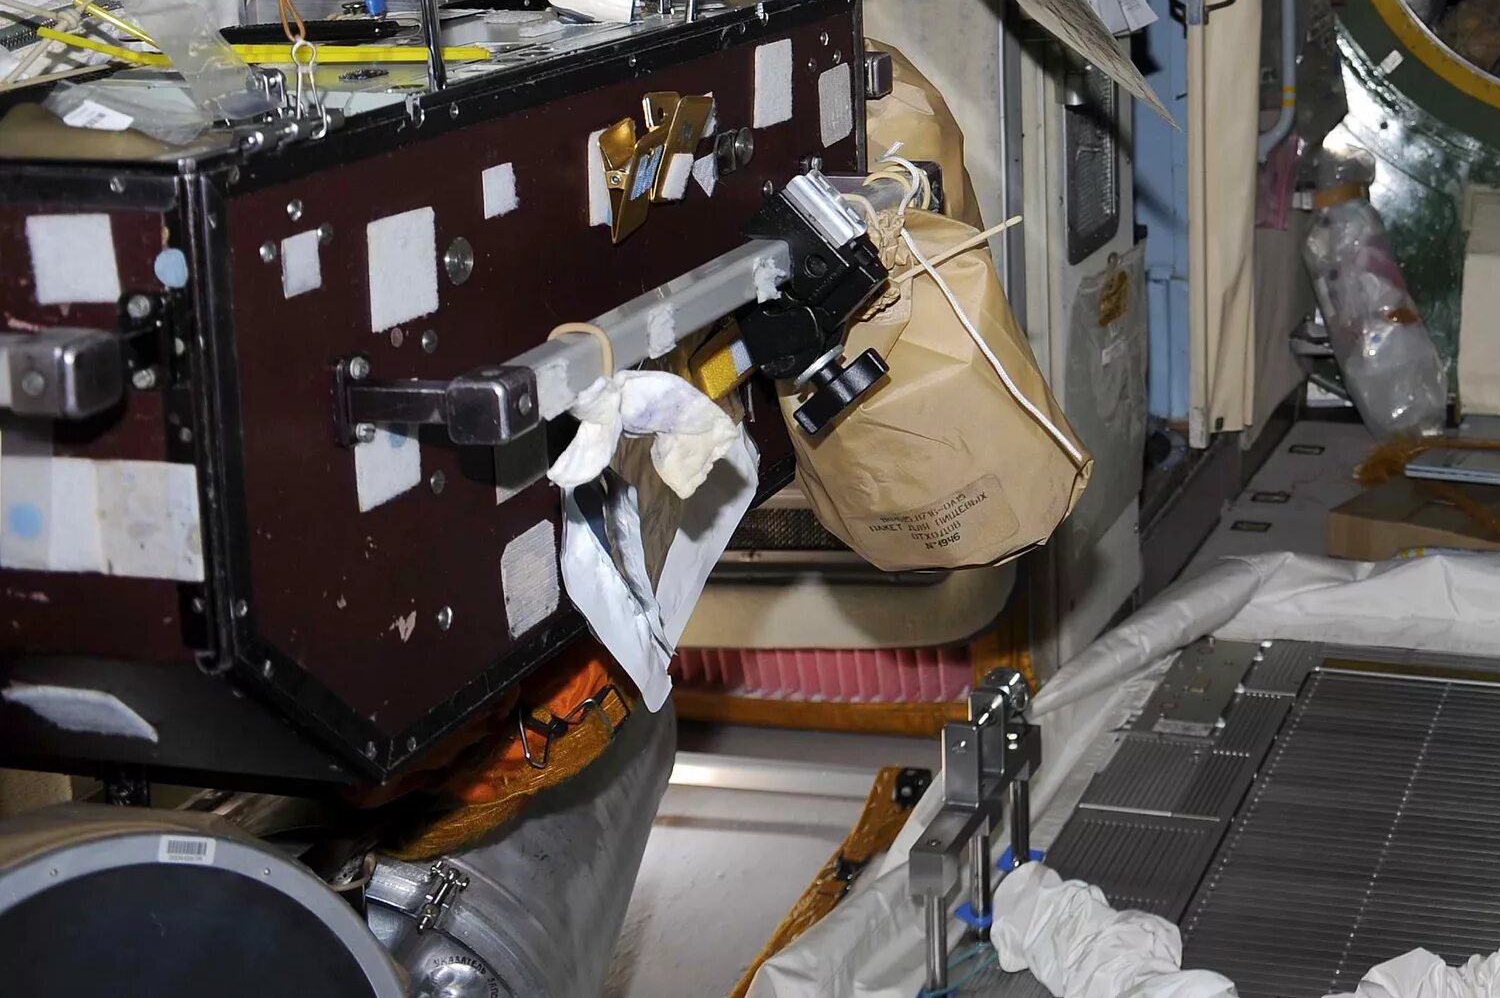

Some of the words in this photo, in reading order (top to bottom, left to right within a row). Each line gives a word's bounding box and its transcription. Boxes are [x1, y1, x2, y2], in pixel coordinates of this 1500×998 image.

[869, 523, 902, 532] ПАКЕТ
[908, 524, 930, 532] ДЛЯ
[935, 491, 988, 525] ПИЩЕВЫХ
[911, 520, 962, 541] ОТХОДОВ
